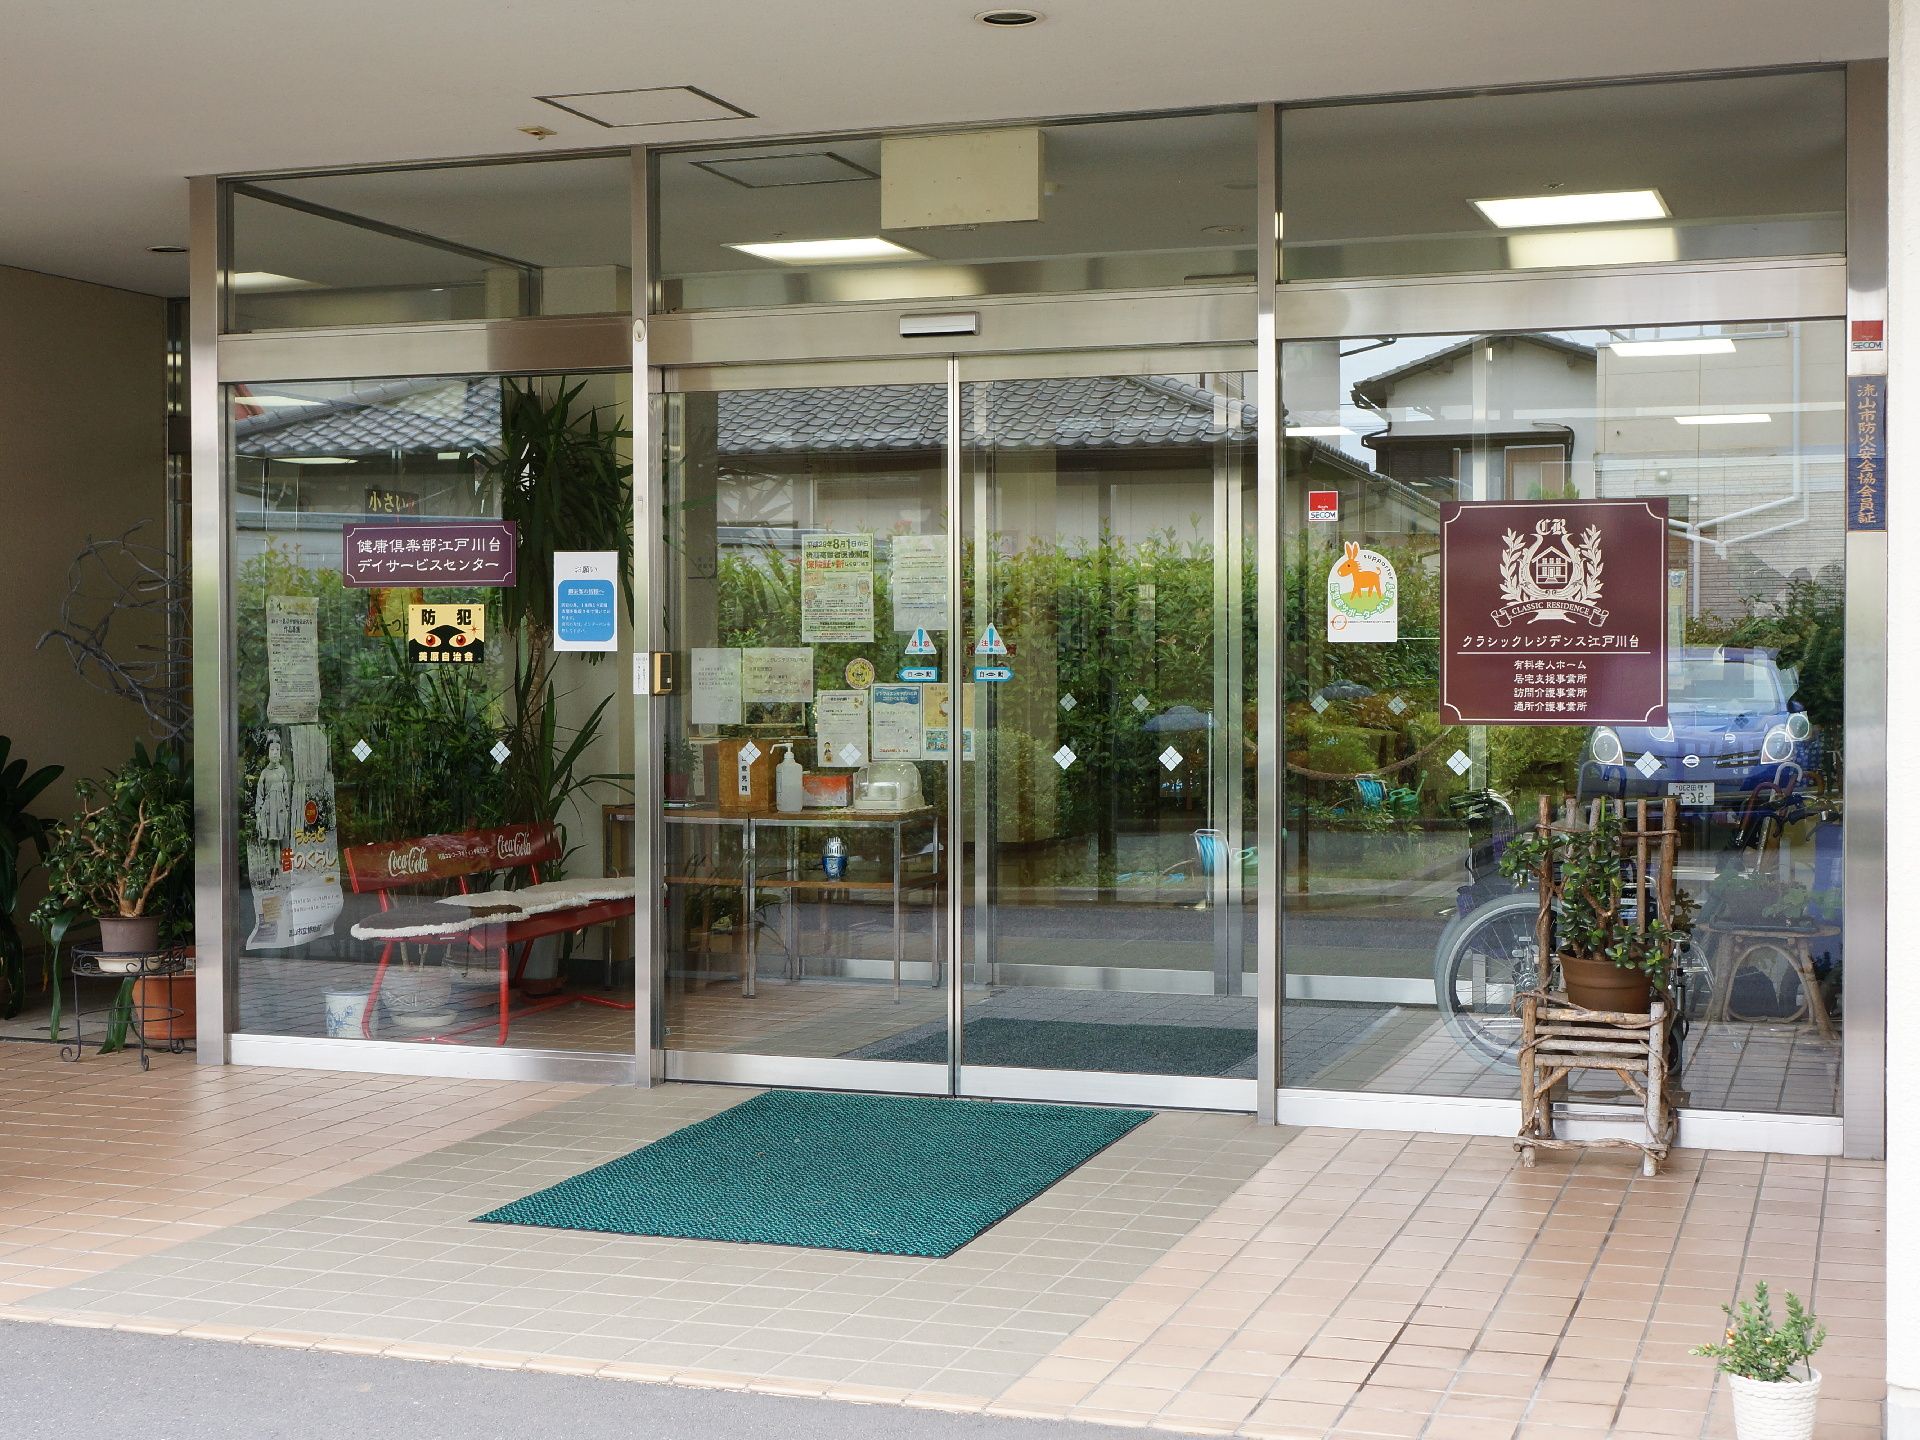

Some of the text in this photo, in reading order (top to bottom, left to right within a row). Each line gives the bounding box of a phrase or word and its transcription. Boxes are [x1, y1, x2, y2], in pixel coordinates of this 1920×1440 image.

[1852, 341, 1882, 349] SECOM
[1857, 385, 1878, 524] 流山市防火安全協会員証
[1310, 511, 1336, 519] SECOM
[1535, 518, 1569, 536] CR
[357, 557, 500, 573] デイサービスセンター
[574, 565, 598, 574] お願い
[1363, 554, 1394, 580] supporter
[1329, 582, 1396, 620] 認知症サポーターがいます
[1511, 601, 1590, 616] CLASSIC RESIDENCE
[421, 608, 472, 626] 防犯
[1462, 635, 1640, 648] クラシックレジデンス江戸川台
[1513, 660, 1587, 670] 有料老人ホーム
[1513, 673, 1588, 684] 居宅支援事業所
[1513, 687, 1588, 698] 訪問介護事業所
[1513, 701, 1588, 712] 通所介護事業所
